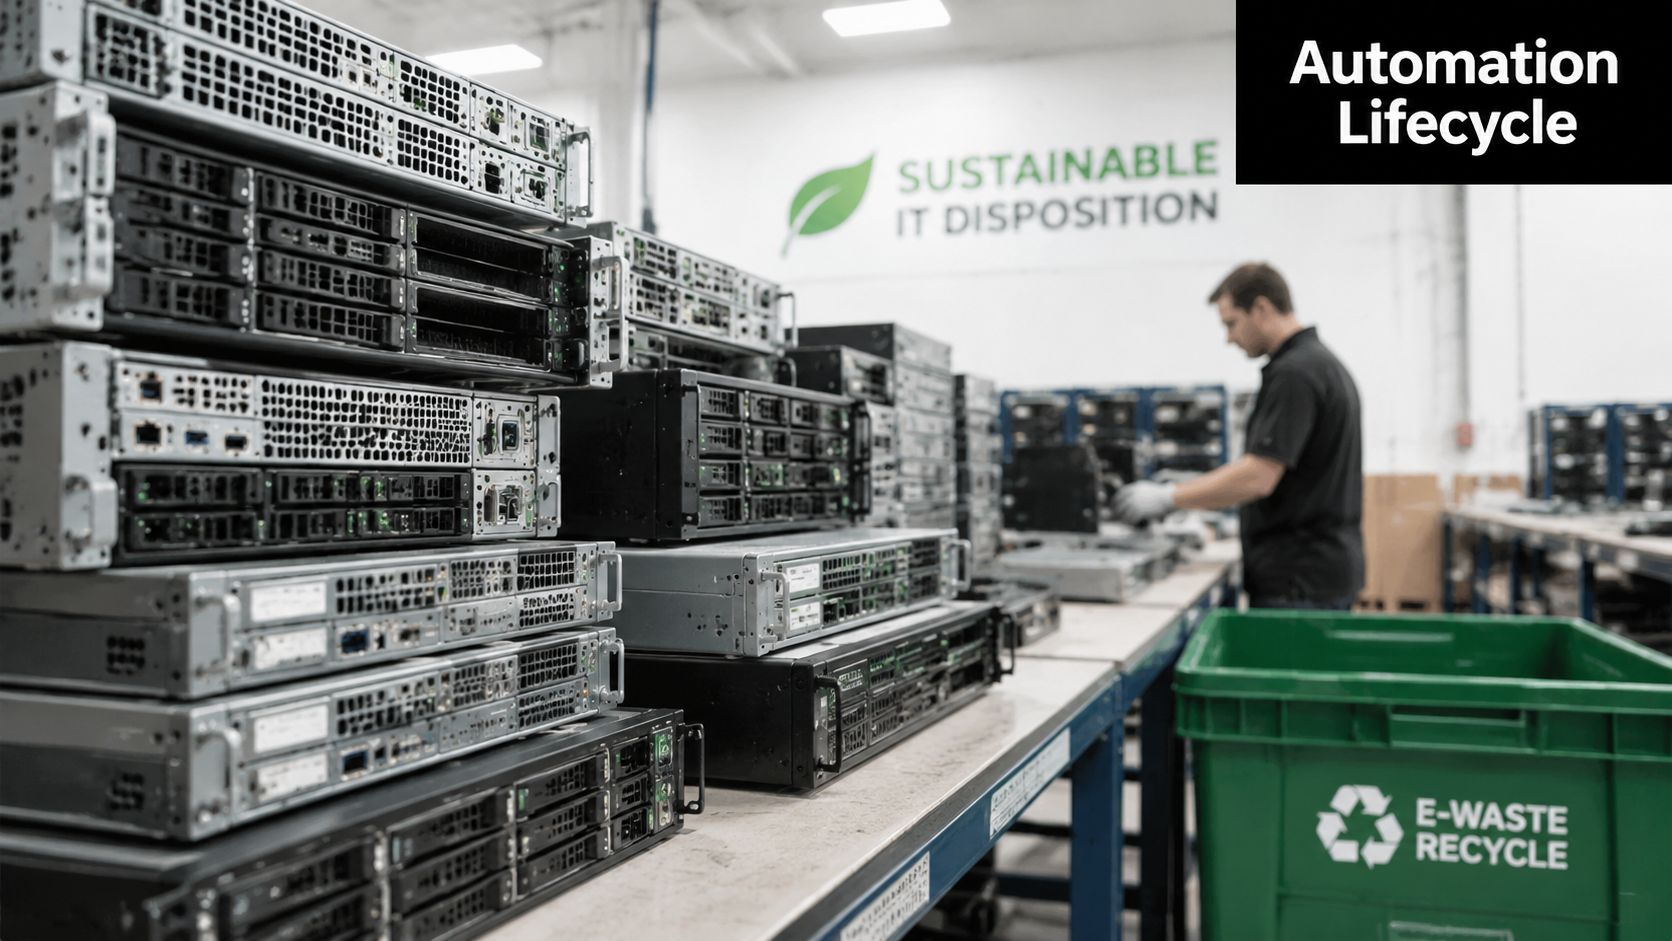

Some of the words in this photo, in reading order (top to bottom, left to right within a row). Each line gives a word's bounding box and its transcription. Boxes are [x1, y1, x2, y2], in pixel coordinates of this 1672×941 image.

[897, 138, 1219, 193] SUSTAINABLE
[896, 207, 926, 238] IT
[943, 190, 1219, 235] DISPOSITION
[1415, 797, 1569, 836] E-WASTE
[1415, 831, 1569, 871] RECYCLE
